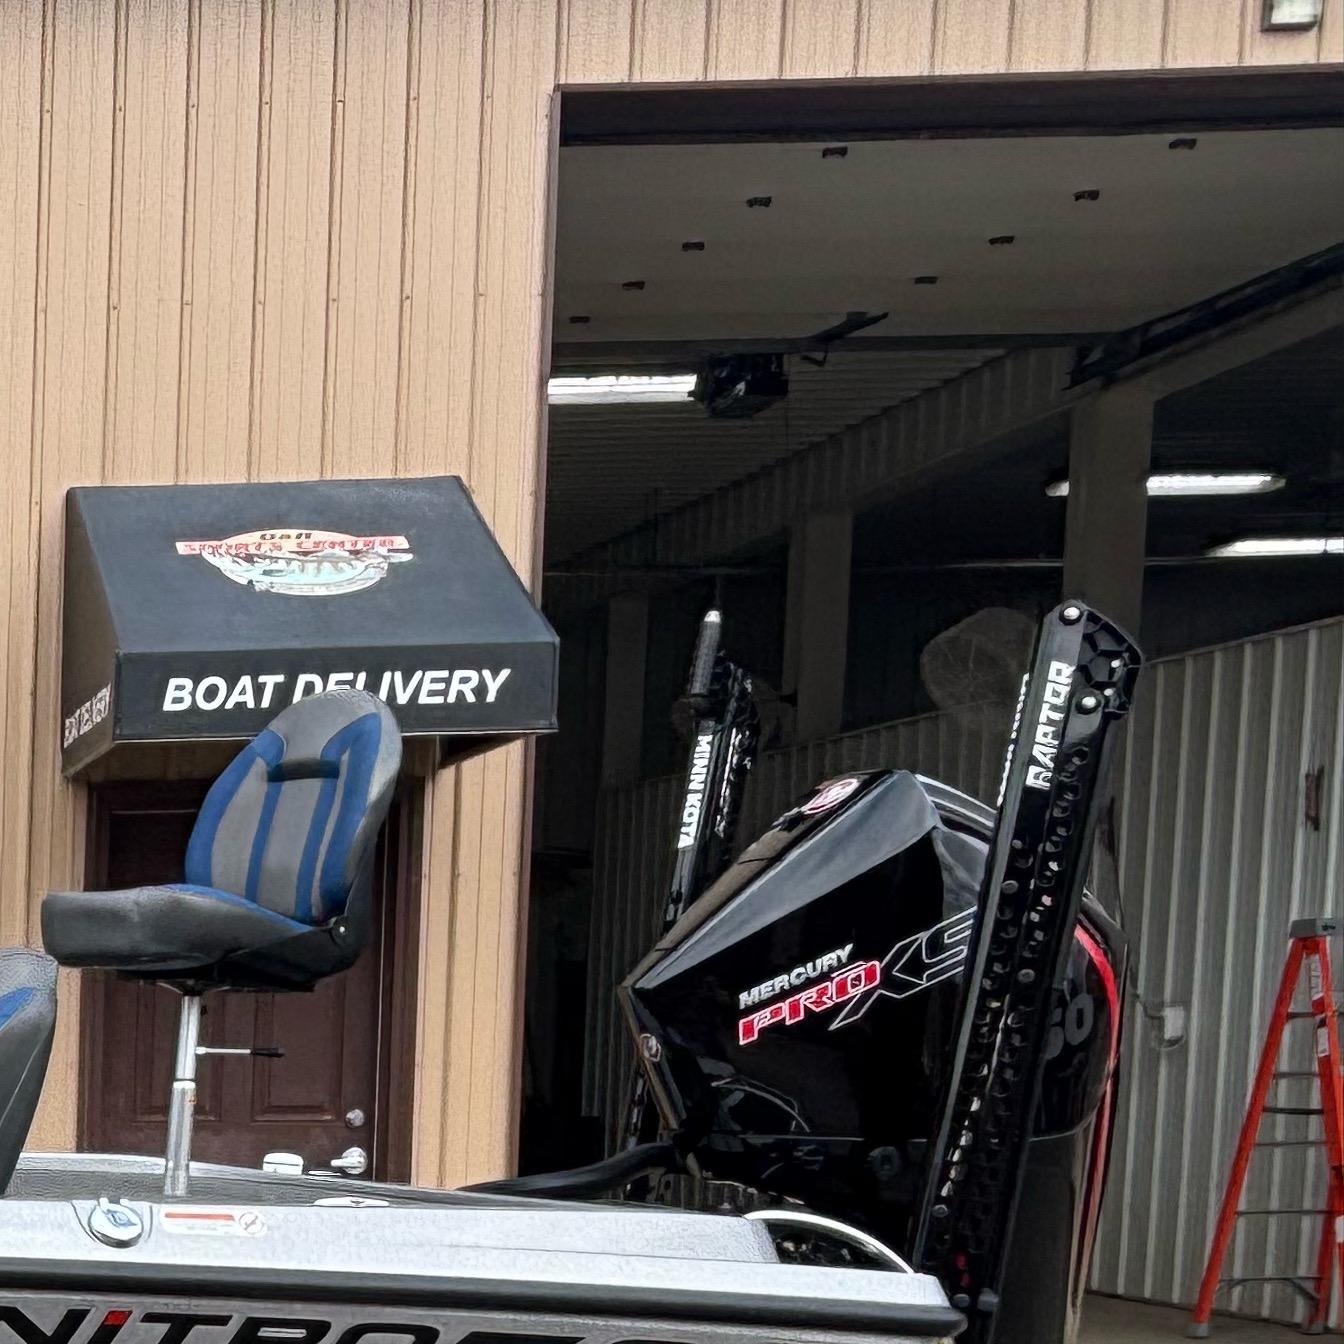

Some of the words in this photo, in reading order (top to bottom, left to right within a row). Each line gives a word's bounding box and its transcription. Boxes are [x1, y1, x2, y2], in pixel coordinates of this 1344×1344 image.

[162, 674, 285, 712] BOAT
[1025, 660, 1078, 791] RAPTOR
[687, 734, 714, 791] MINN
[677, 792, 703, 849] KOTA
[738, 943, 855, 1010] MERCURY
[738, 960, 882, 1046] PRO
